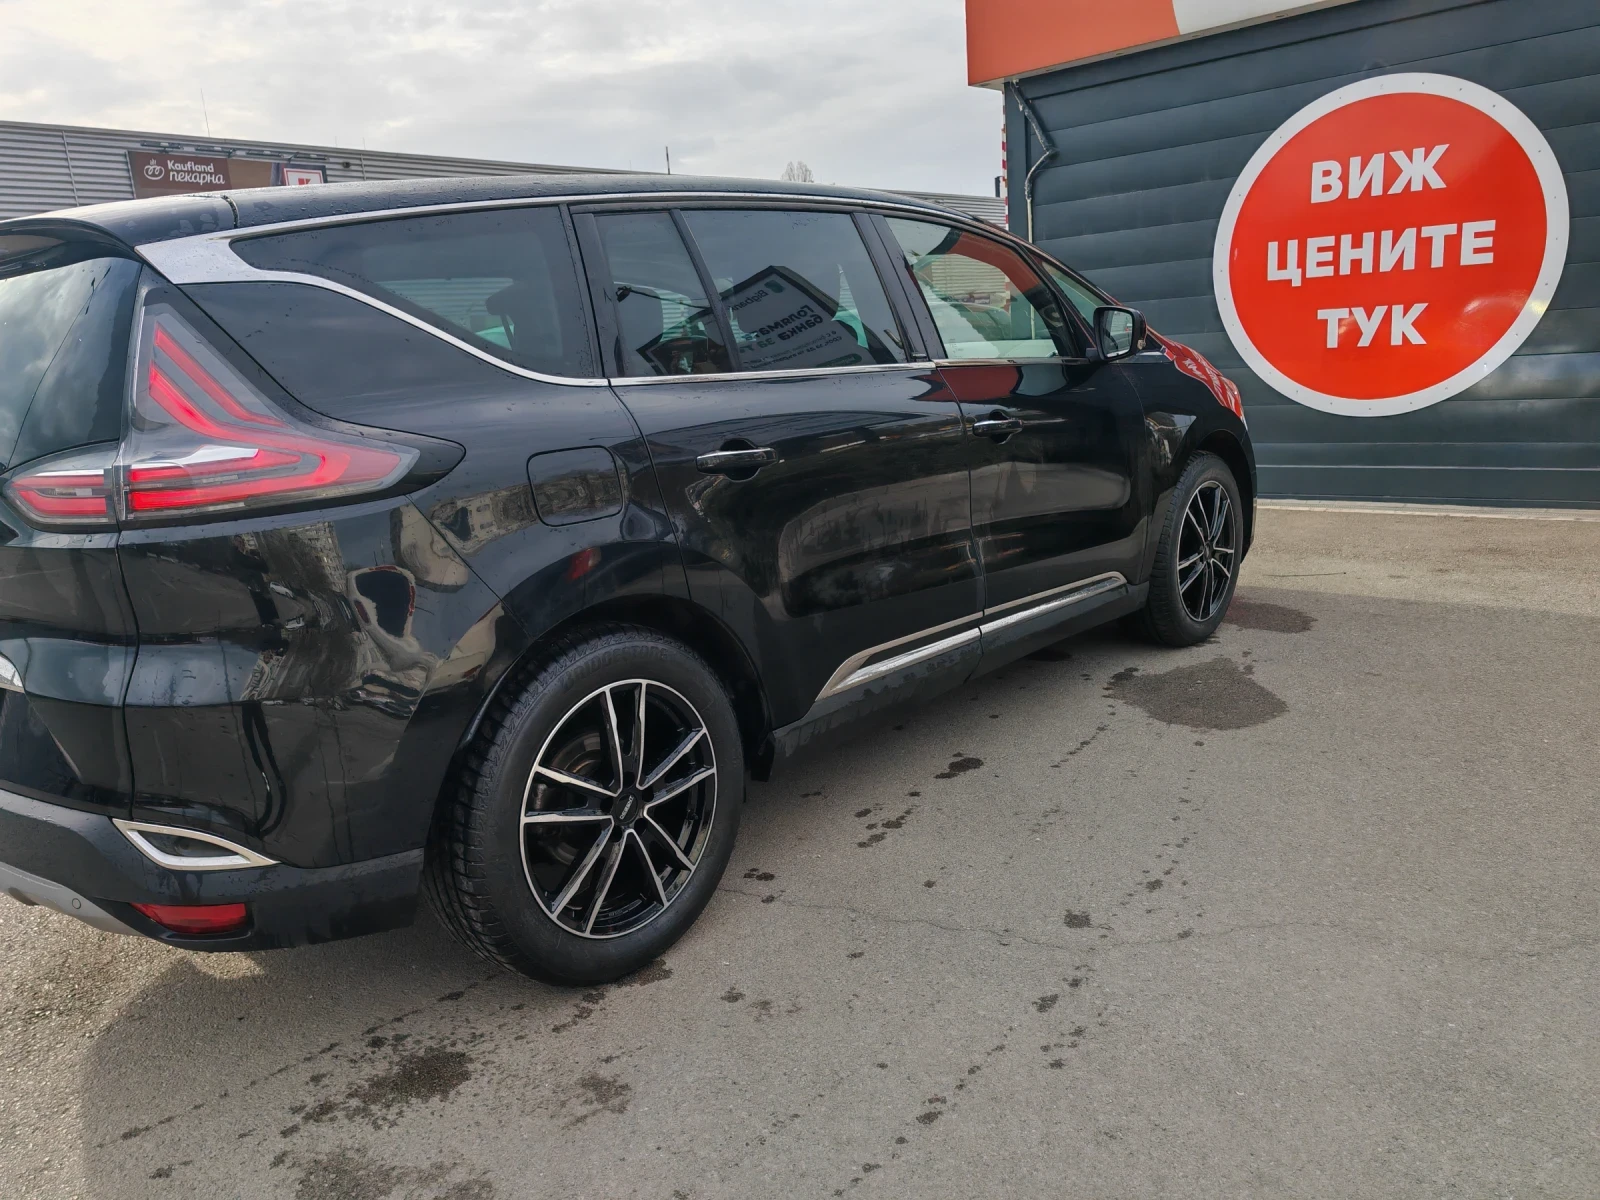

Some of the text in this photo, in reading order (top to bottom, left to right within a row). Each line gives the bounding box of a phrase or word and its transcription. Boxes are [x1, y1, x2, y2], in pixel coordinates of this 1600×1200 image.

[167, 160, 214, 172] Kaufland
[169, 171, 225, 186] пекарна
[1310, 143, 1450, 204] ВИЖ
[1267, 219, 1496, 287] ЦЕНИТЕ
[1317, 303, 1429, 349] ТУК
